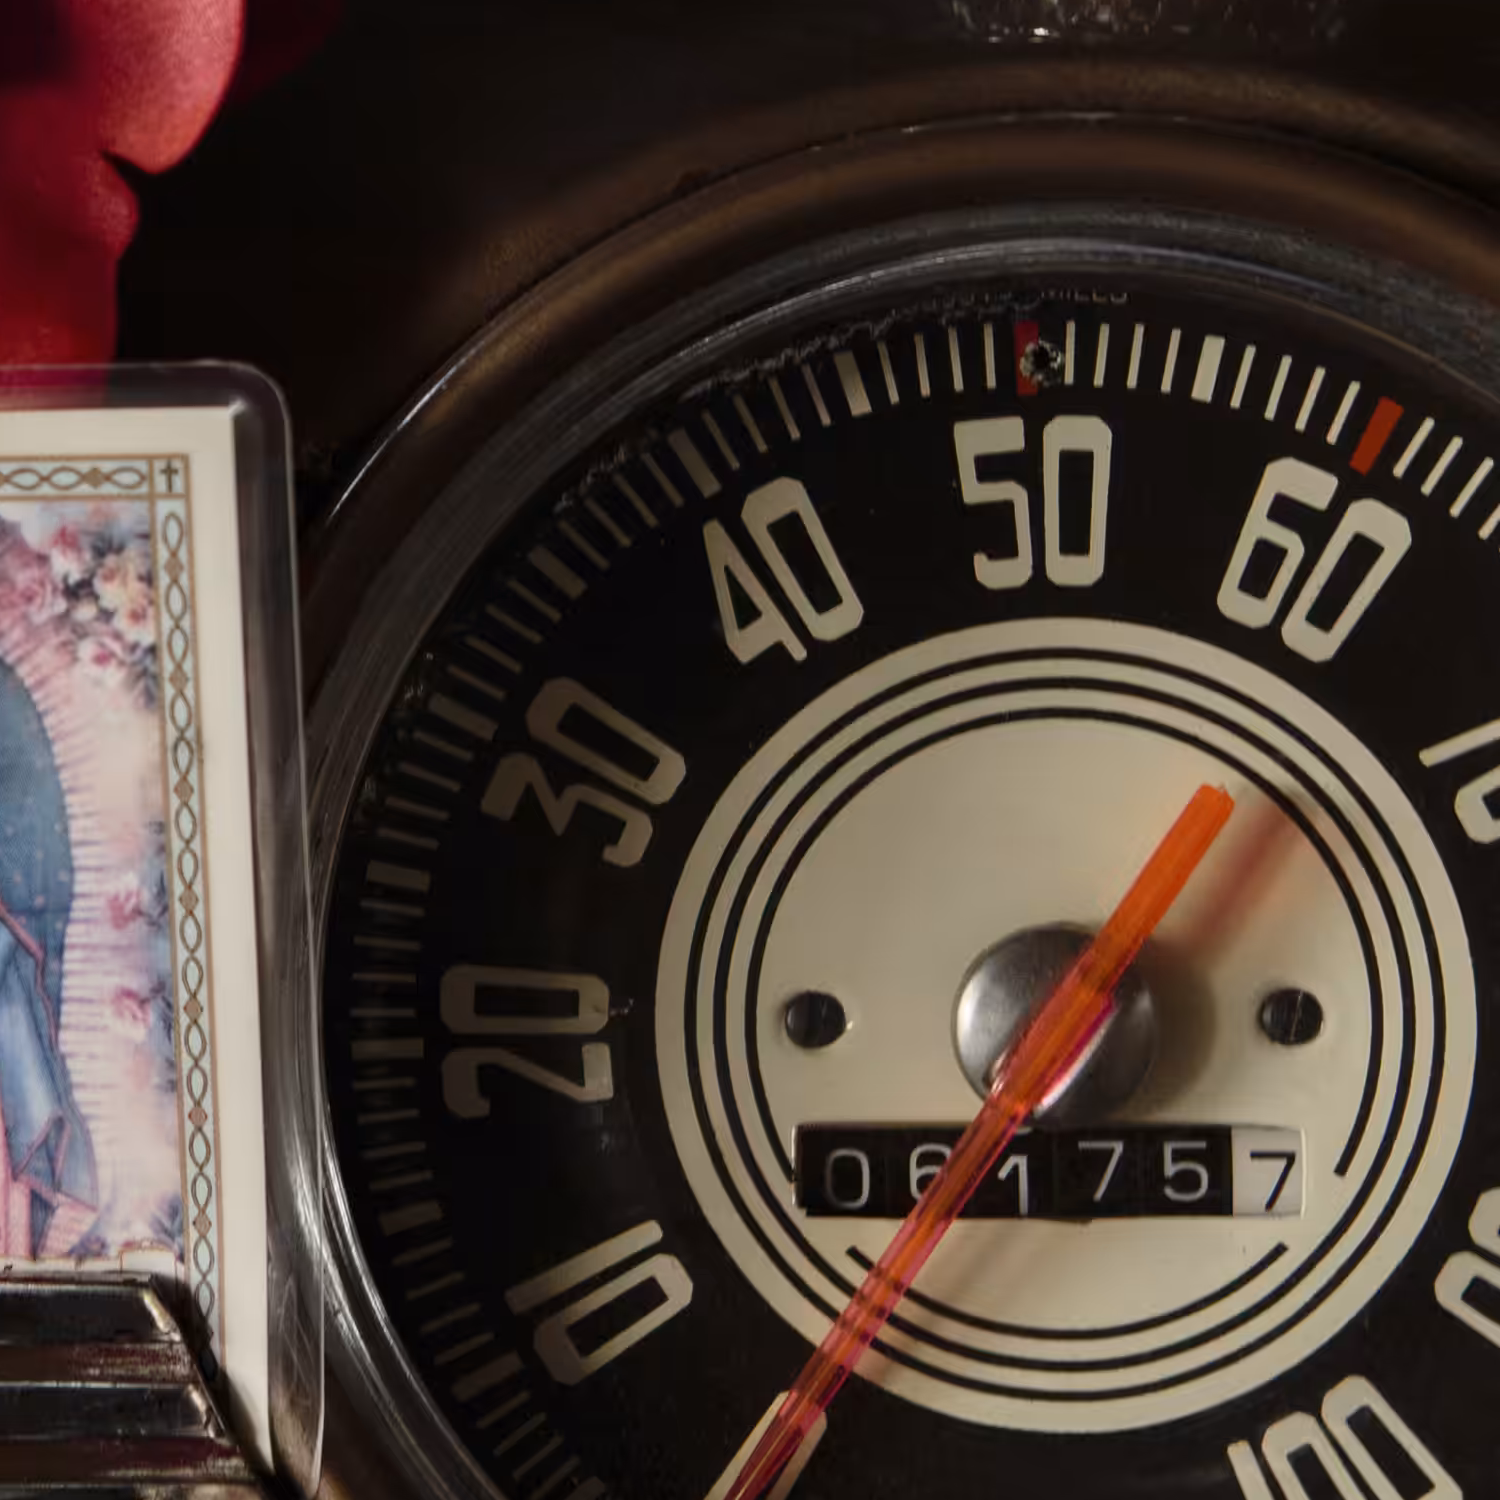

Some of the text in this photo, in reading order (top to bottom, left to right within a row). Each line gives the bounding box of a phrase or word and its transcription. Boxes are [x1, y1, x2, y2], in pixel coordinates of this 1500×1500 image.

[702, 477, 863, 664] 40
[954, 415, 1111, 589] 50
[1216, 457, 1411, 662] 60
[482, 677, 686, 867] 30
[440, 965, 613, 1118] 20
[505, 1220, 693, 1386] 10
